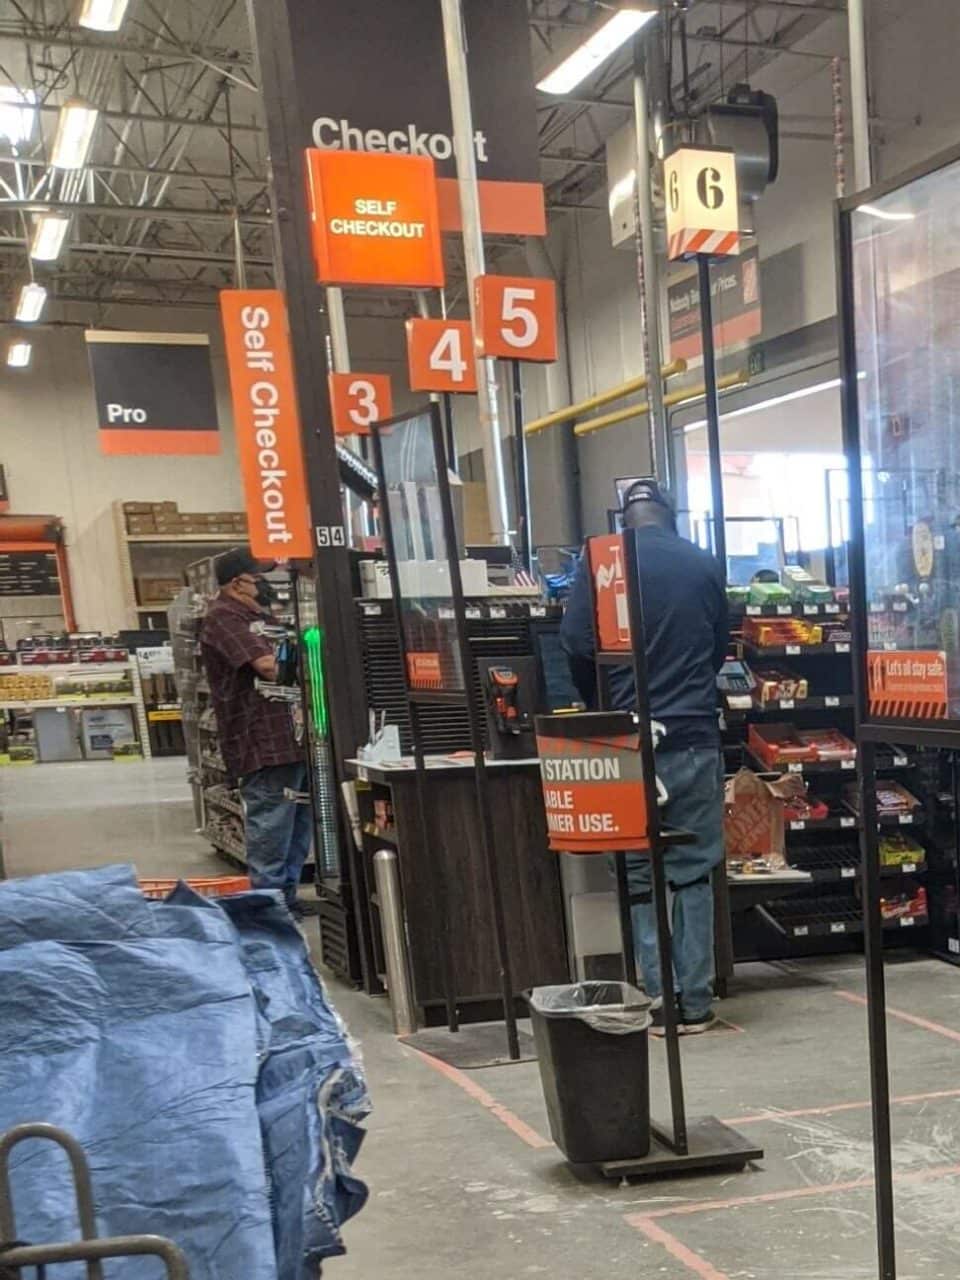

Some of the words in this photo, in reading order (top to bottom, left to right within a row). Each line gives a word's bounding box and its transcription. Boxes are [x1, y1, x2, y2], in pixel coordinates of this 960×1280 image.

[355, 199, 397, 216] SELF
[669, 170, 679, 213] 6
[696, 167, 724, 210] 6
[330, 219, 425, 238] CHECKOUT
[500, 287, 539, 348] 5
[241, 306, 276, 373] Self
[429, 328, 467, 382] 4
[107, 403, 147, 423] Pro
[348, 380, 379, 426] 3
[250, 381, 293, 544] Checkout
[545, 757, 620, 781] STATION
[579, 813, 620, 832] USE.
